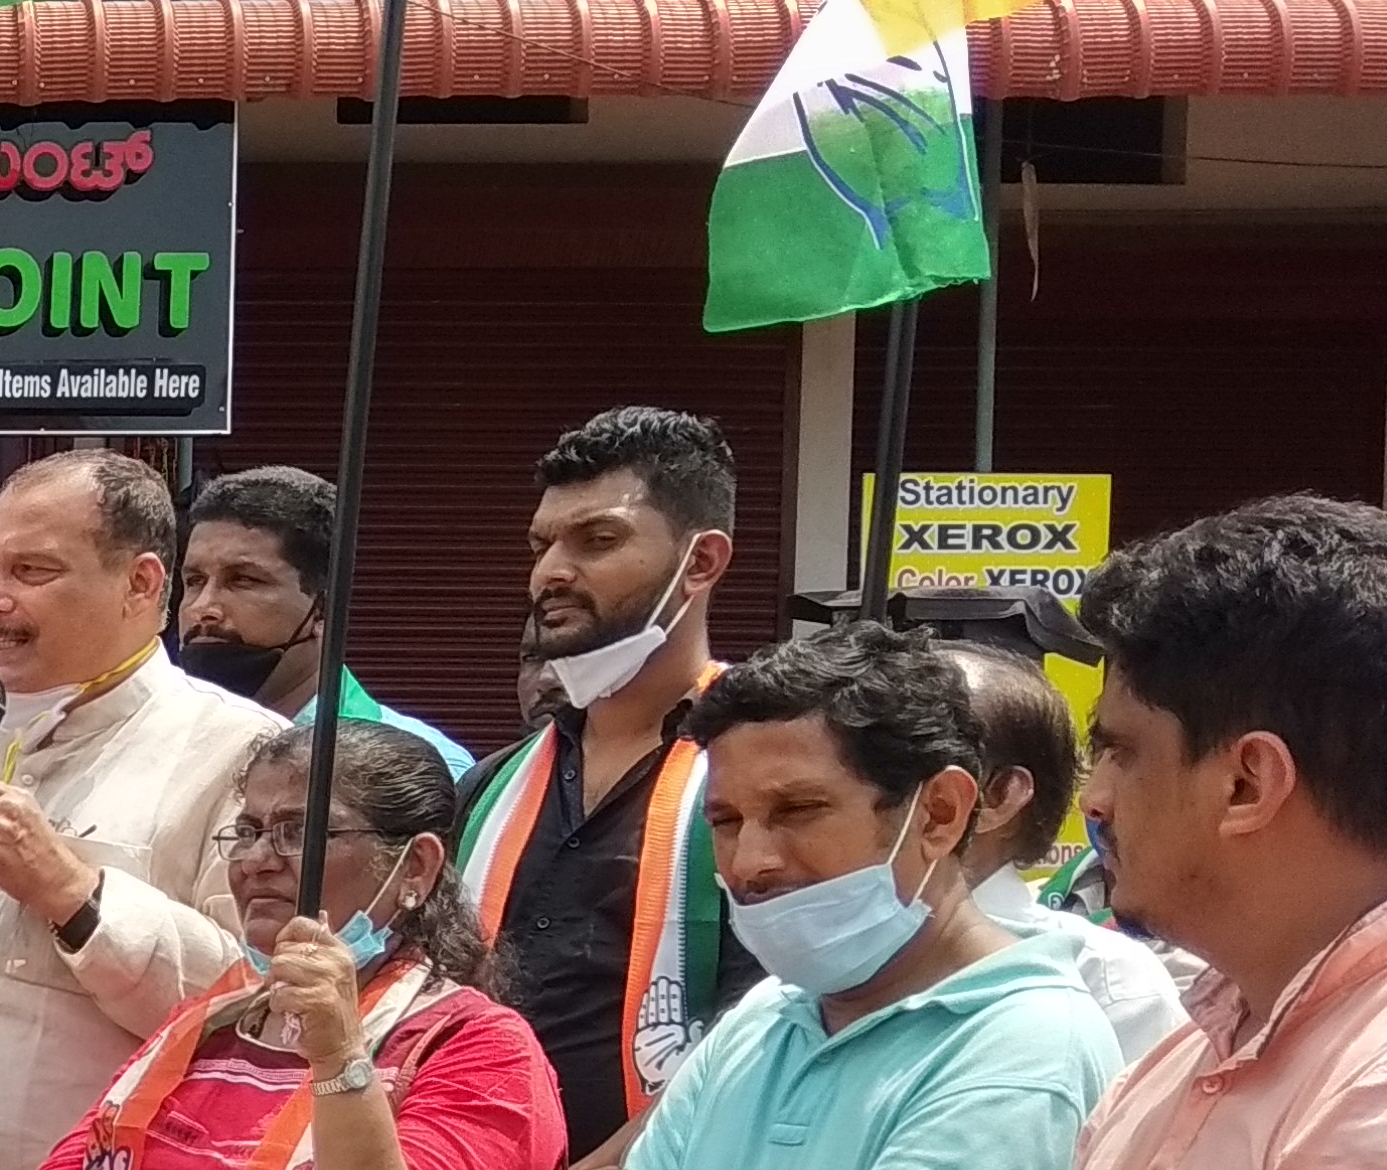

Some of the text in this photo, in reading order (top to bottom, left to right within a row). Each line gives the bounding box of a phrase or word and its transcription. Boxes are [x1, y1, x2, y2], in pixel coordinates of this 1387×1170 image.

[56, 367, 148, 398] Available
[154, 368, 200, 398] Here
[899, 478, 1076, 512] Stationary
[897, 523, 1078, 551] XEROX
